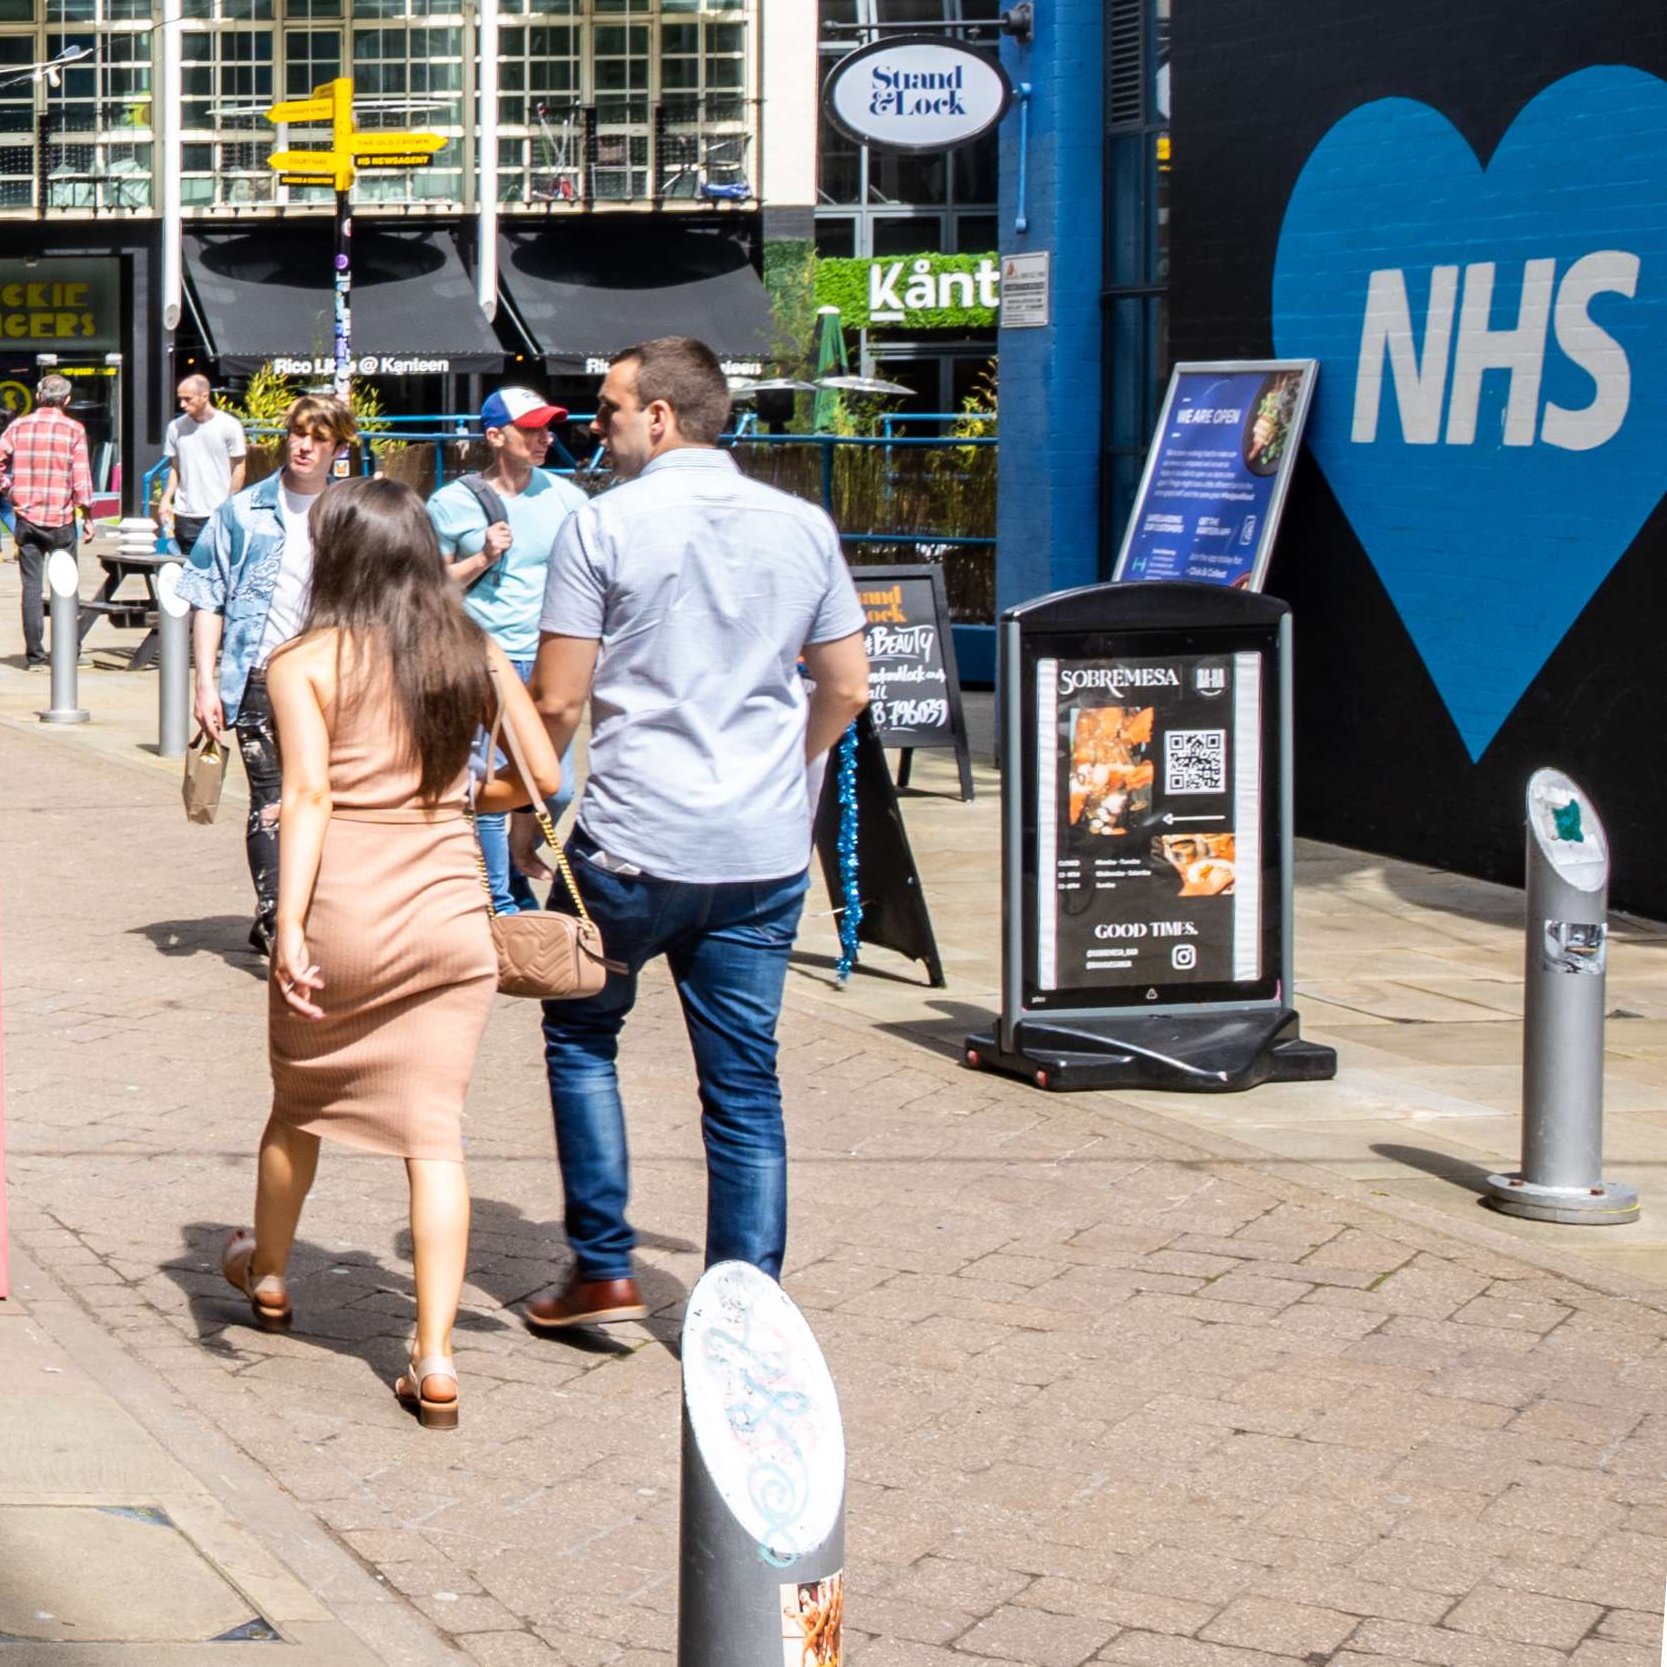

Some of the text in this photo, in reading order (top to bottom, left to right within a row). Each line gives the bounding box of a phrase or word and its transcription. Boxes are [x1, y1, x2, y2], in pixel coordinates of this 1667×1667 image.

[871, 65, 964, 91] Strand
[869, 261, 1000, 311] Kånt
[1350, 249, 1641, 452] NHS
[274, 358, 312, 375] Rico
[359, 356, 378, 375] @
[380, 357, 450, 375] Kanteen
[586, 358, 611, 374] Ric
[1177, 408, 1242, 424] WE ARE OPEN
[1059, 668, 1179, 698] SOBREMESA
[1094, 921, 1199, 939] GOOD TIMES.
